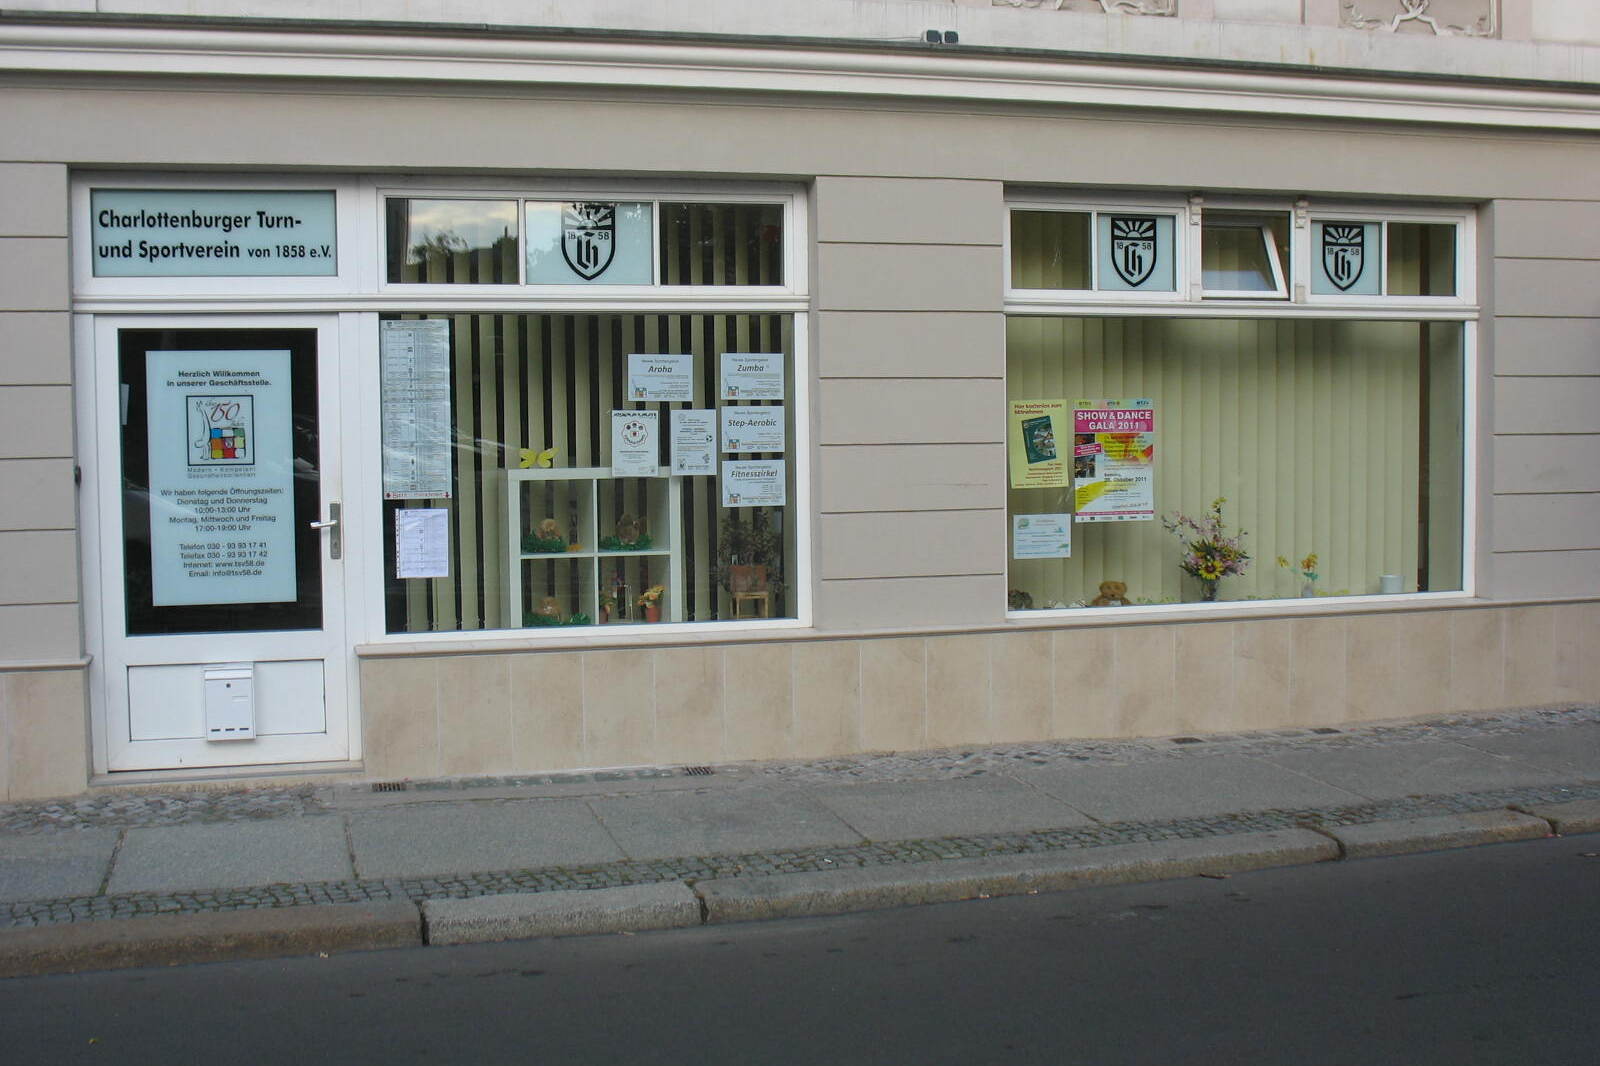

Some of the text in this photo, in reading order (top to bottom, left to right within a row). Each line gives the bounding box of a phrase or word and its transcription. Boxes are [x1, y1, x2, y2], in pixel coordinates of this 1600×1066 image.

[98, 209, 302, 232] Charlottenburger Turn-
[598, 231, 610, 240] 58
[99, 240, 332, 263] und Sportverein von 1858 e.V.
[647, 365, 673, 373] Aroha
[737, 364, 765, 372] Zumba
[178, 370, 261, 378] Herzlich Willkommen
[208, 379, 272, 387] Geschäftsstelle.
[210, 402, 241, 422] 150
[1077, 411, 1152, 420] SHOW & DANCE
[728, 419, 777, 428] Step-Aerobic
[1088, 422, 1139, 430] GALA 2011
[731, 470, 778, 478] Fitnesszirkel
[198, 488, 228, 497] folgende
[177, 498, 209, 506] Dienstag
[226, 497, 268, 505] Donnerstag
[200, 515, 235, 523] Mittwoch
[251, 514, 277, 523] Freitag
[179, 543, 205, 551] Telefon
[180, 552, 205, 560] Telefax
